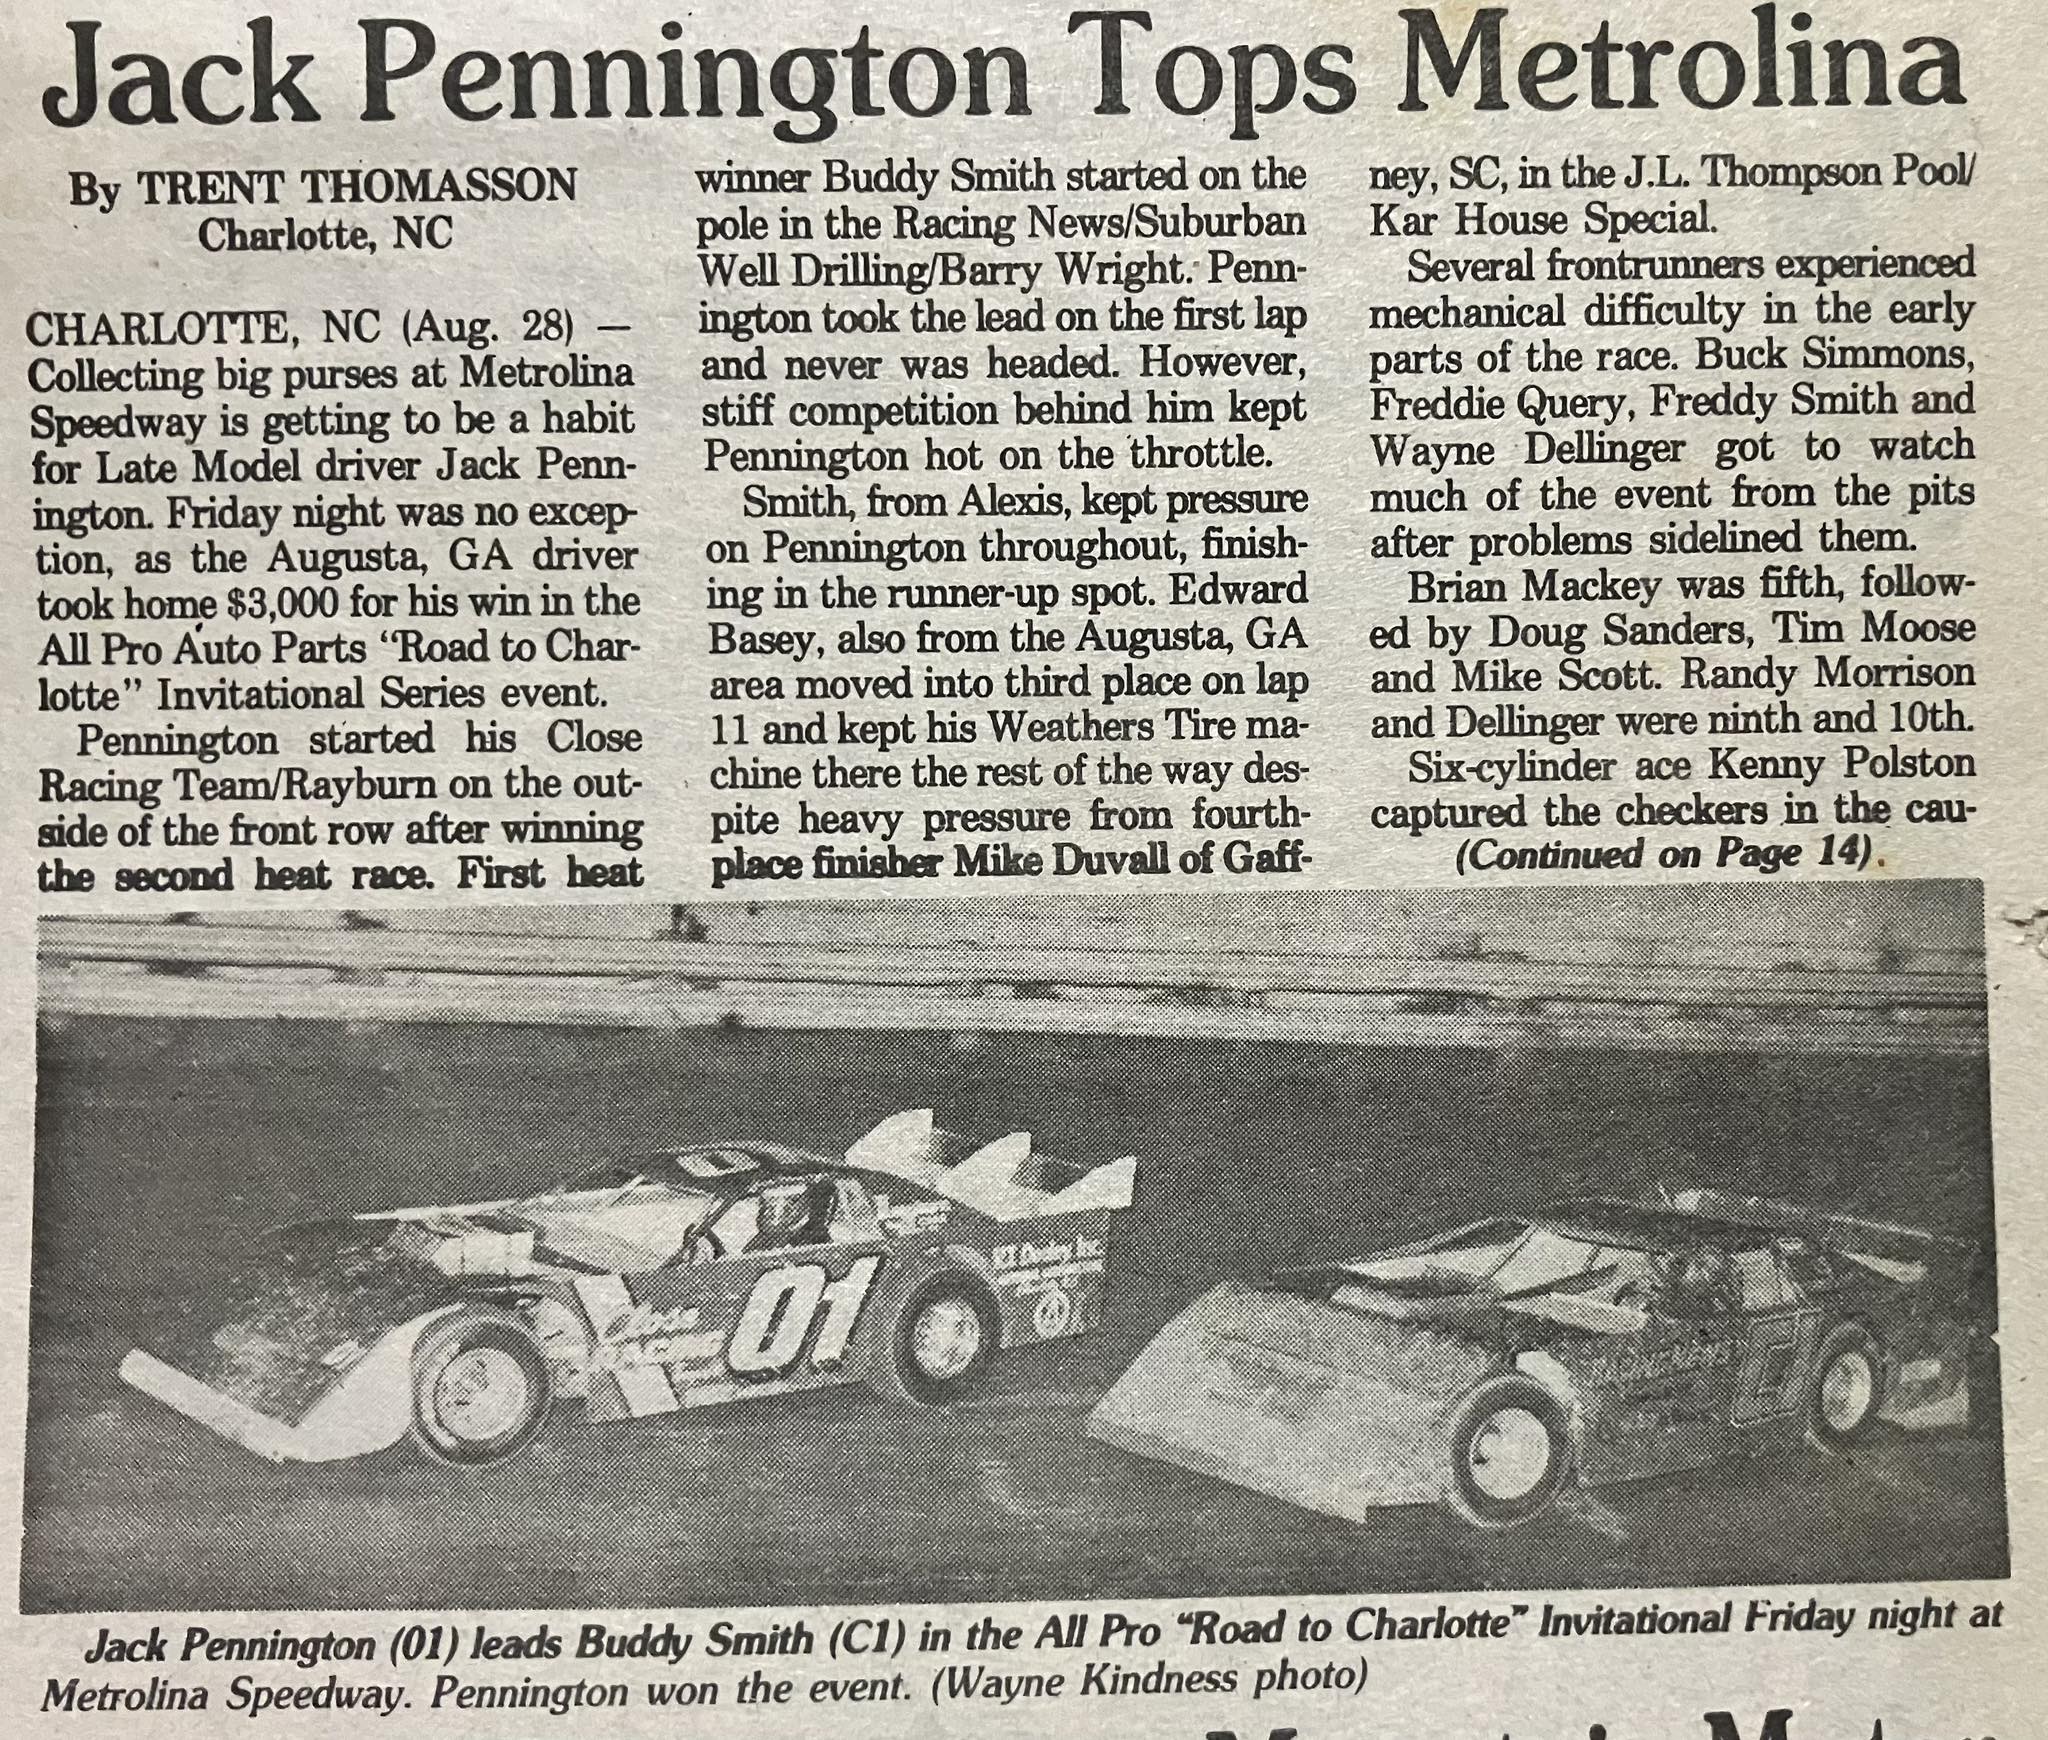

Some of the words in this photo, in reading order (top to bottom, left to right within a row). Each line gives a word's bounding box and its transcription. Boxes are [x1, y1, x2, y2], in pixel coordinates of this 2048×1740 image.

[43, 17, 321, 127] Jack
[359, 19, 1031, 143] Pennington
[1068, 11, 1356, 140] Tops
[1398, 3, 1967, 111] Metrolina
[68, 171, 121, 214] By
[137, 170, 285, 205] TRENT
[301, 167, 578, 203] THOMASSON
[694, 159, 812, 193] winner
[823, 157, 940, 201] Buddy
[951, 157, 1056, 192] Smith
[1067, 156, 1189, 191] started
[1199, 166, 1241, 190] on
[1251, 155, 1307, 190] the
[198, 217, 377, 255] Charlotte,
[393, 215, 453, 249] NC
[1370, 203, 1438, 236] Kar
[1455, 202, 1568, 235] House
[1585, 199, 1718, 243] Special.
[697, 252, 780, 287] Well
[791, 252, 1043, 295] Drilling/Barry
[1055, 250, 1192, 293] Wright.
[1208, 250, 1307, 283] Penn-
[27, 358, 205, 399] Collecting
[216, 357, 273, 398] big
[283, 365, 398, 398] purses
[411, 358, 447, 388] at
[460, 353, 635, 388] Metrolina
[701, 346, 767, 380] and
[784, 357, 883, 380] never
[900, 356, 969, 379] was
[987, 343, 1119, 379] headed.
[1139, 344, 1306, 381] However,
[1370, 385, 1505, 420] Freddie
[1517, 385, 1635, 426] Query,
[1650, 382, 1778, 424] Freddy
[1792, 381, 1898, 415] Smith
[1912, 380, 1976, 414] and
[32, 450, 82, 485] for
[96, 451, 177, 484] Late
[192, 448, 302, 482] Model
[316, 447, 422, 481] driver
[436, 446, 520, 481] Jack
[536, 446, 637, 480] Penn-
[704, 438, 909, 480] Pennington
[925, 437, 983, 470] hot
[999, 447, 1042, 470] on
[1058, 436, 1114, 469] the
[1130, 434, 1273, 469] throttle.
[33, 497, 154, 539] ington.
[167, 495, 282, 537] Friday
[293, 494, 386, 536] night
[396, 503, 464, 527] was
[475, 503, 518, 526] no
[529, 503, 638, 534] excep-
[1370, 478, 1468, 513] much
[1486, 477, 1522, 511] of
[1540, 476, 1597, 510] the
[1615, 477, 1712, 509] event
[1731, 474, 1816, 507] from
[1834, 473, 1891, 506] the
[1908, 473, 1975, 515] pits
[706, 540, 749, 564] on
[763, 530, 967, 571] Pennington
[979, 527, 1187, 569] throughout,
[1201, 525, 1309, 559] finish-
[37, 587, 114, 621] took
[124, 586, 217, 620] home
[227, 586, 339, 623] $3,000
[350, 584, 398, 617] for
[408, 583, 458, 617] his
[468, 584, 531, 616] win
[540, 583, 574, 616] in
[584, 582, 641, 616] the
[1408, 570, 1507, 603] Brian
[1522, 567, 1663, 608] Mackey
[1677, 576, 1745, 599] was
[1760, 564, 1844, 603] fifth,
[1861, 563, 1976, 597] follow-
[708, 622, 824, 662] Basey,
[837, 620, 906, 654] also
[916, 620, 999, 653] from
[1010, 619, 1065, 652] the
[1075, 619, 1234, 659] Augusta,
[1246, 616, 1309, 649] GA
[157, 675, 365, 710] Invitational
[381, 675, 485, 709] Series
[501, 677, 607, 708] event.
[1371, 705, 1435, 739] and
[1446, 704, 1605, 744] Dellinger
[1616, 712, 1698, 736] were
[1708, 700, 1802, 734] ninth
[1813, 699, 1877, 733] and
[1891, 699, 1975, 732] 10th.
[39, 768, 163, 810] Racing
[173, 766, 438, 808] Team/Rayburn
[449, 776, 493, 799] on
[504, 765, 562, 798] the
[573, 768, 643, 798] out-
[1409, 748, 1618, 790] Six-cylinder
[1636, 757, 1692, 780] ace
[1708, 747, 1826, 787] Kenny
[1844, 744, 1977, 778] Polston
[37, 858, 95, 893] the
[115, 857, 234, 892] second
[254, 857, 332, 891] heat
[352, 866, 435, 890] race.
[457, 855, 546, 889] First
[567, 854, 645, 888] heat
[711, 846, 803, 889] place
[812, 845, 944, 879] finisher
[954, 843, 1043, 877] Mike
[1052, 841, 1171, 876] Duvall
[1179, 840, 1215, 874] of
[1223, 839, 1313, 874] Gaff-
[1456, 837, 1644, 876] (Continued
[1659, 847, 1701, 868] on
[1716, 836, 1802, 874] Page
[1819, 834, 1873, 871] 14)
[727, 1254, 880, 1374] 01
[84, 1627, 168, 1664] Jack
[180, 1627, 376, 1668] Pennington
[390, 1625, 459, 1667] (01)
[470, 1625, 562, 1660] leads
[575, 1624, 693, 1665] Buddy
[705, 1621, 814, 1657] Smith
[829, 1619, 906, 1659] (C1)
[919, 1621, 951, 1652] in
[967, 1617, 1023, 1650] the
[1034, 1614, 1088, 1649] All
[1099, 1614, 1161, 1647] Pro
[1298, 1614, 1332, 1642] to
[1539, 1601, 1732, 1637] Invitational
[1745, 1599, 1856, 1638] Friday
[1868, 1598, 1958, 1637] night
[1969, 1601, 2004, 1628] at
[40, 1677, 209, 1712] Metrolina
[226, 1675, 411, 1718] Speedway.
[430, 1675, 628, 1715] Pennington
[648, 1683, 718, 1706] won
[737, 1670, 793, 1704] the
[809, 1673, 911, 1703] event.
[932, 1666, 1065, 1706] (Wayne
[1080, 1660, 1238, 1696] Kindness
[1253, 1656, 1368, 1700] photo)
